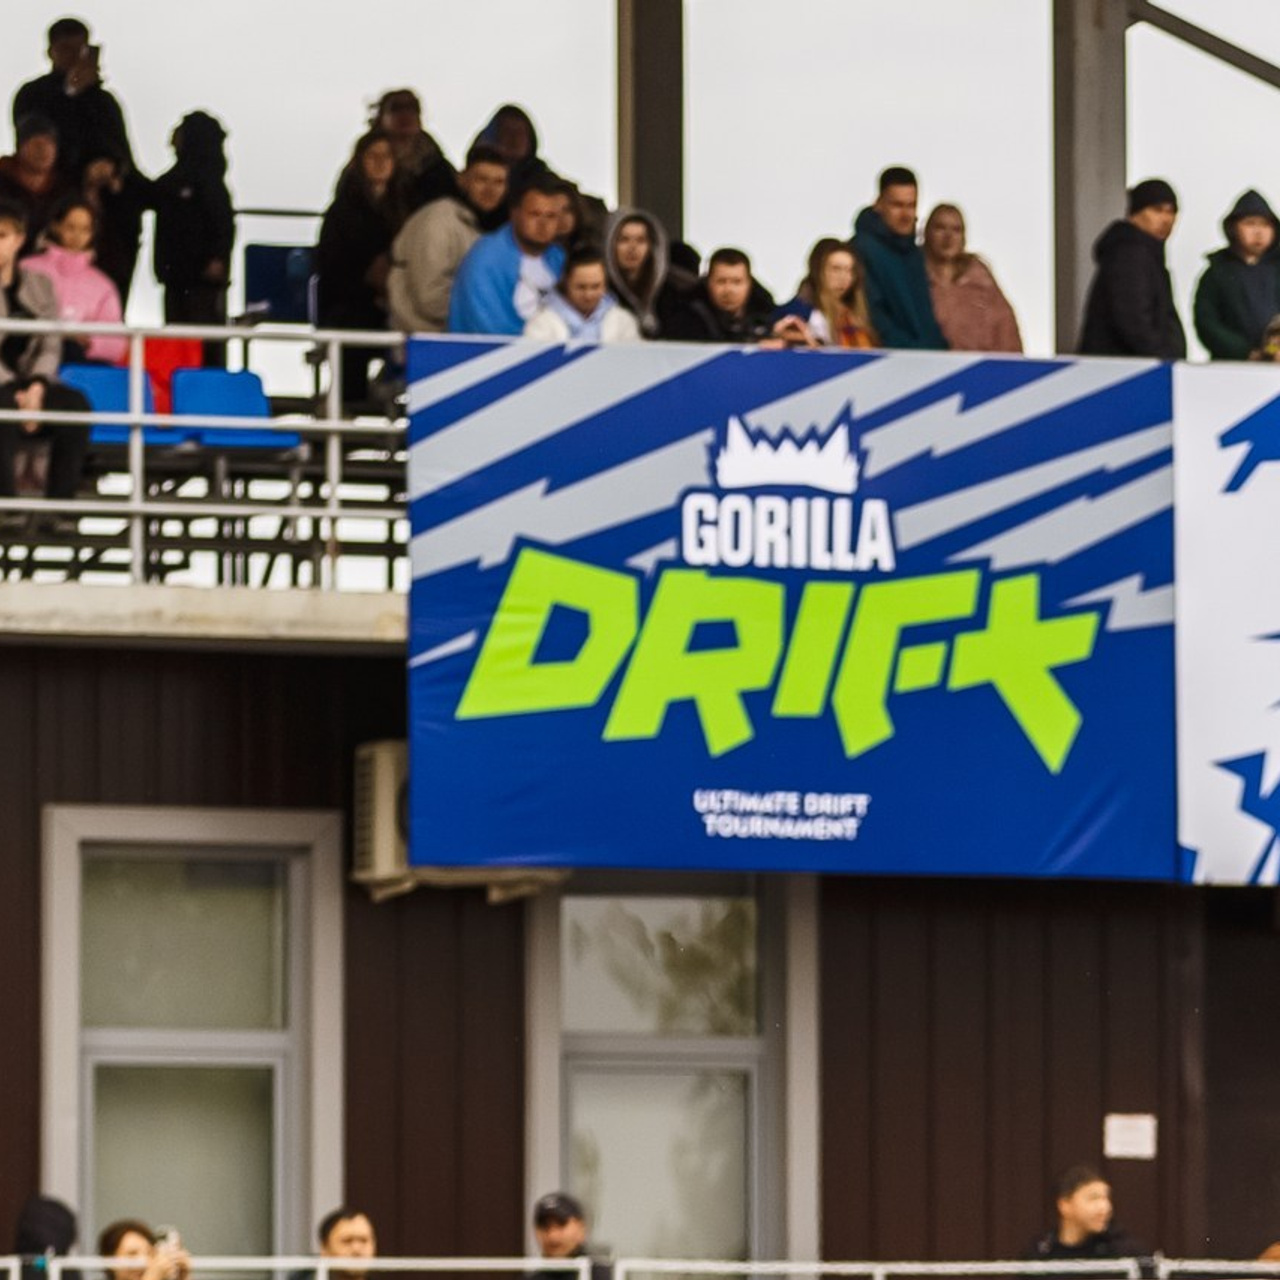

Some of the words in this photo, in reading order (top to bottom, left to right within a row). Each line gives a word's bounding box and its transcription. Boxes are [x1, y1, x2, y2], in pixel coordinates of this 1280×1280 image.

[681, 493, 896, 571] GORILLA
[455, 547, 1099, 775] DRIFT
[692, 789, 799, 815] ULTIMATE
[803, 791, 872, 818] DRIFT
[702, 813, 861, 841] TOURNAMENT
